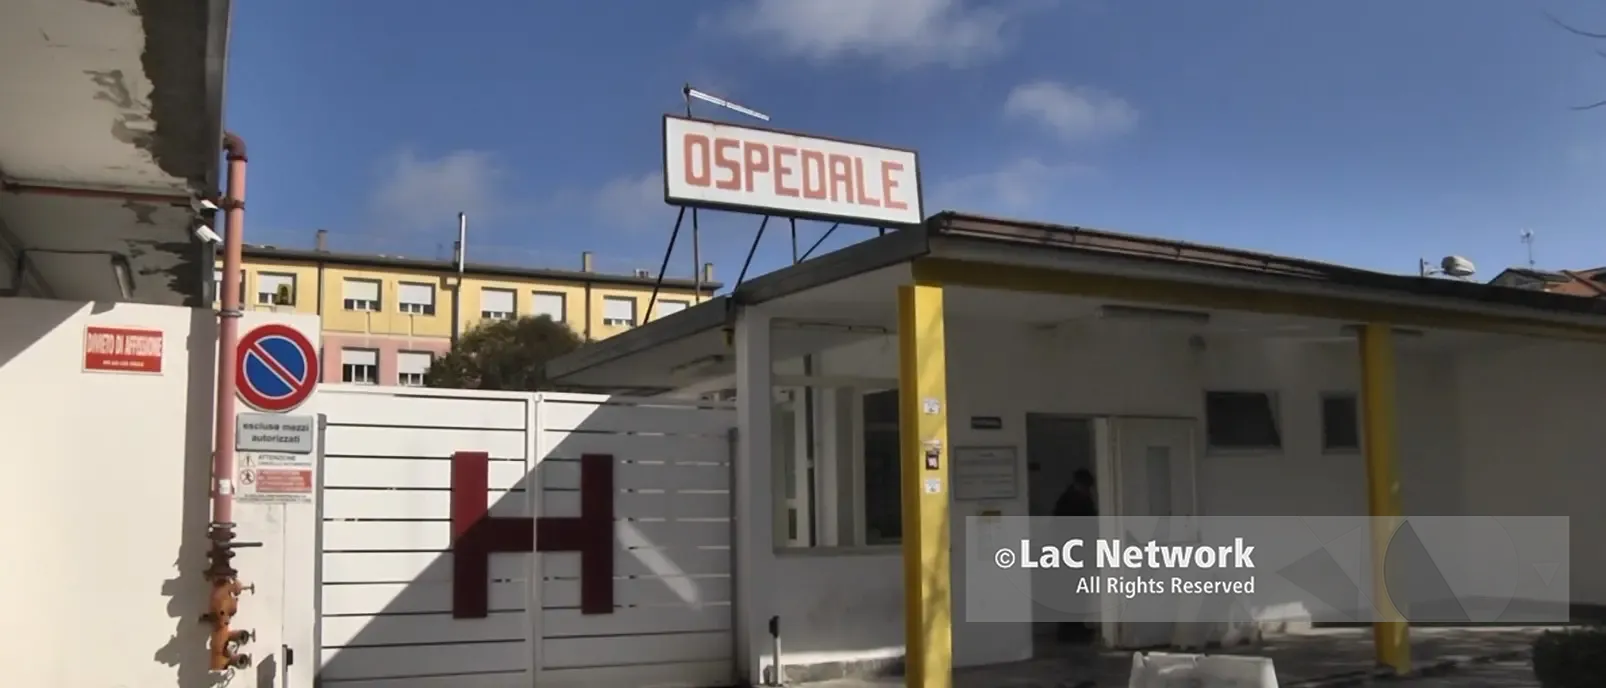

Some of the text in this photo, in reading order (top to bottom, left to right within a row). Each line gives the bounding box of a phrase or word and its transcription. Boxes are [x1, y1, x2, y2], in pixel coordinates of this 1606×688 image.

[684, 133, 908, 210] OSPEDALE
[251, 434, 301, 444] autorizzati
[282, 424, 310, 432] mezzi
[450, 451, 614, 620] H
